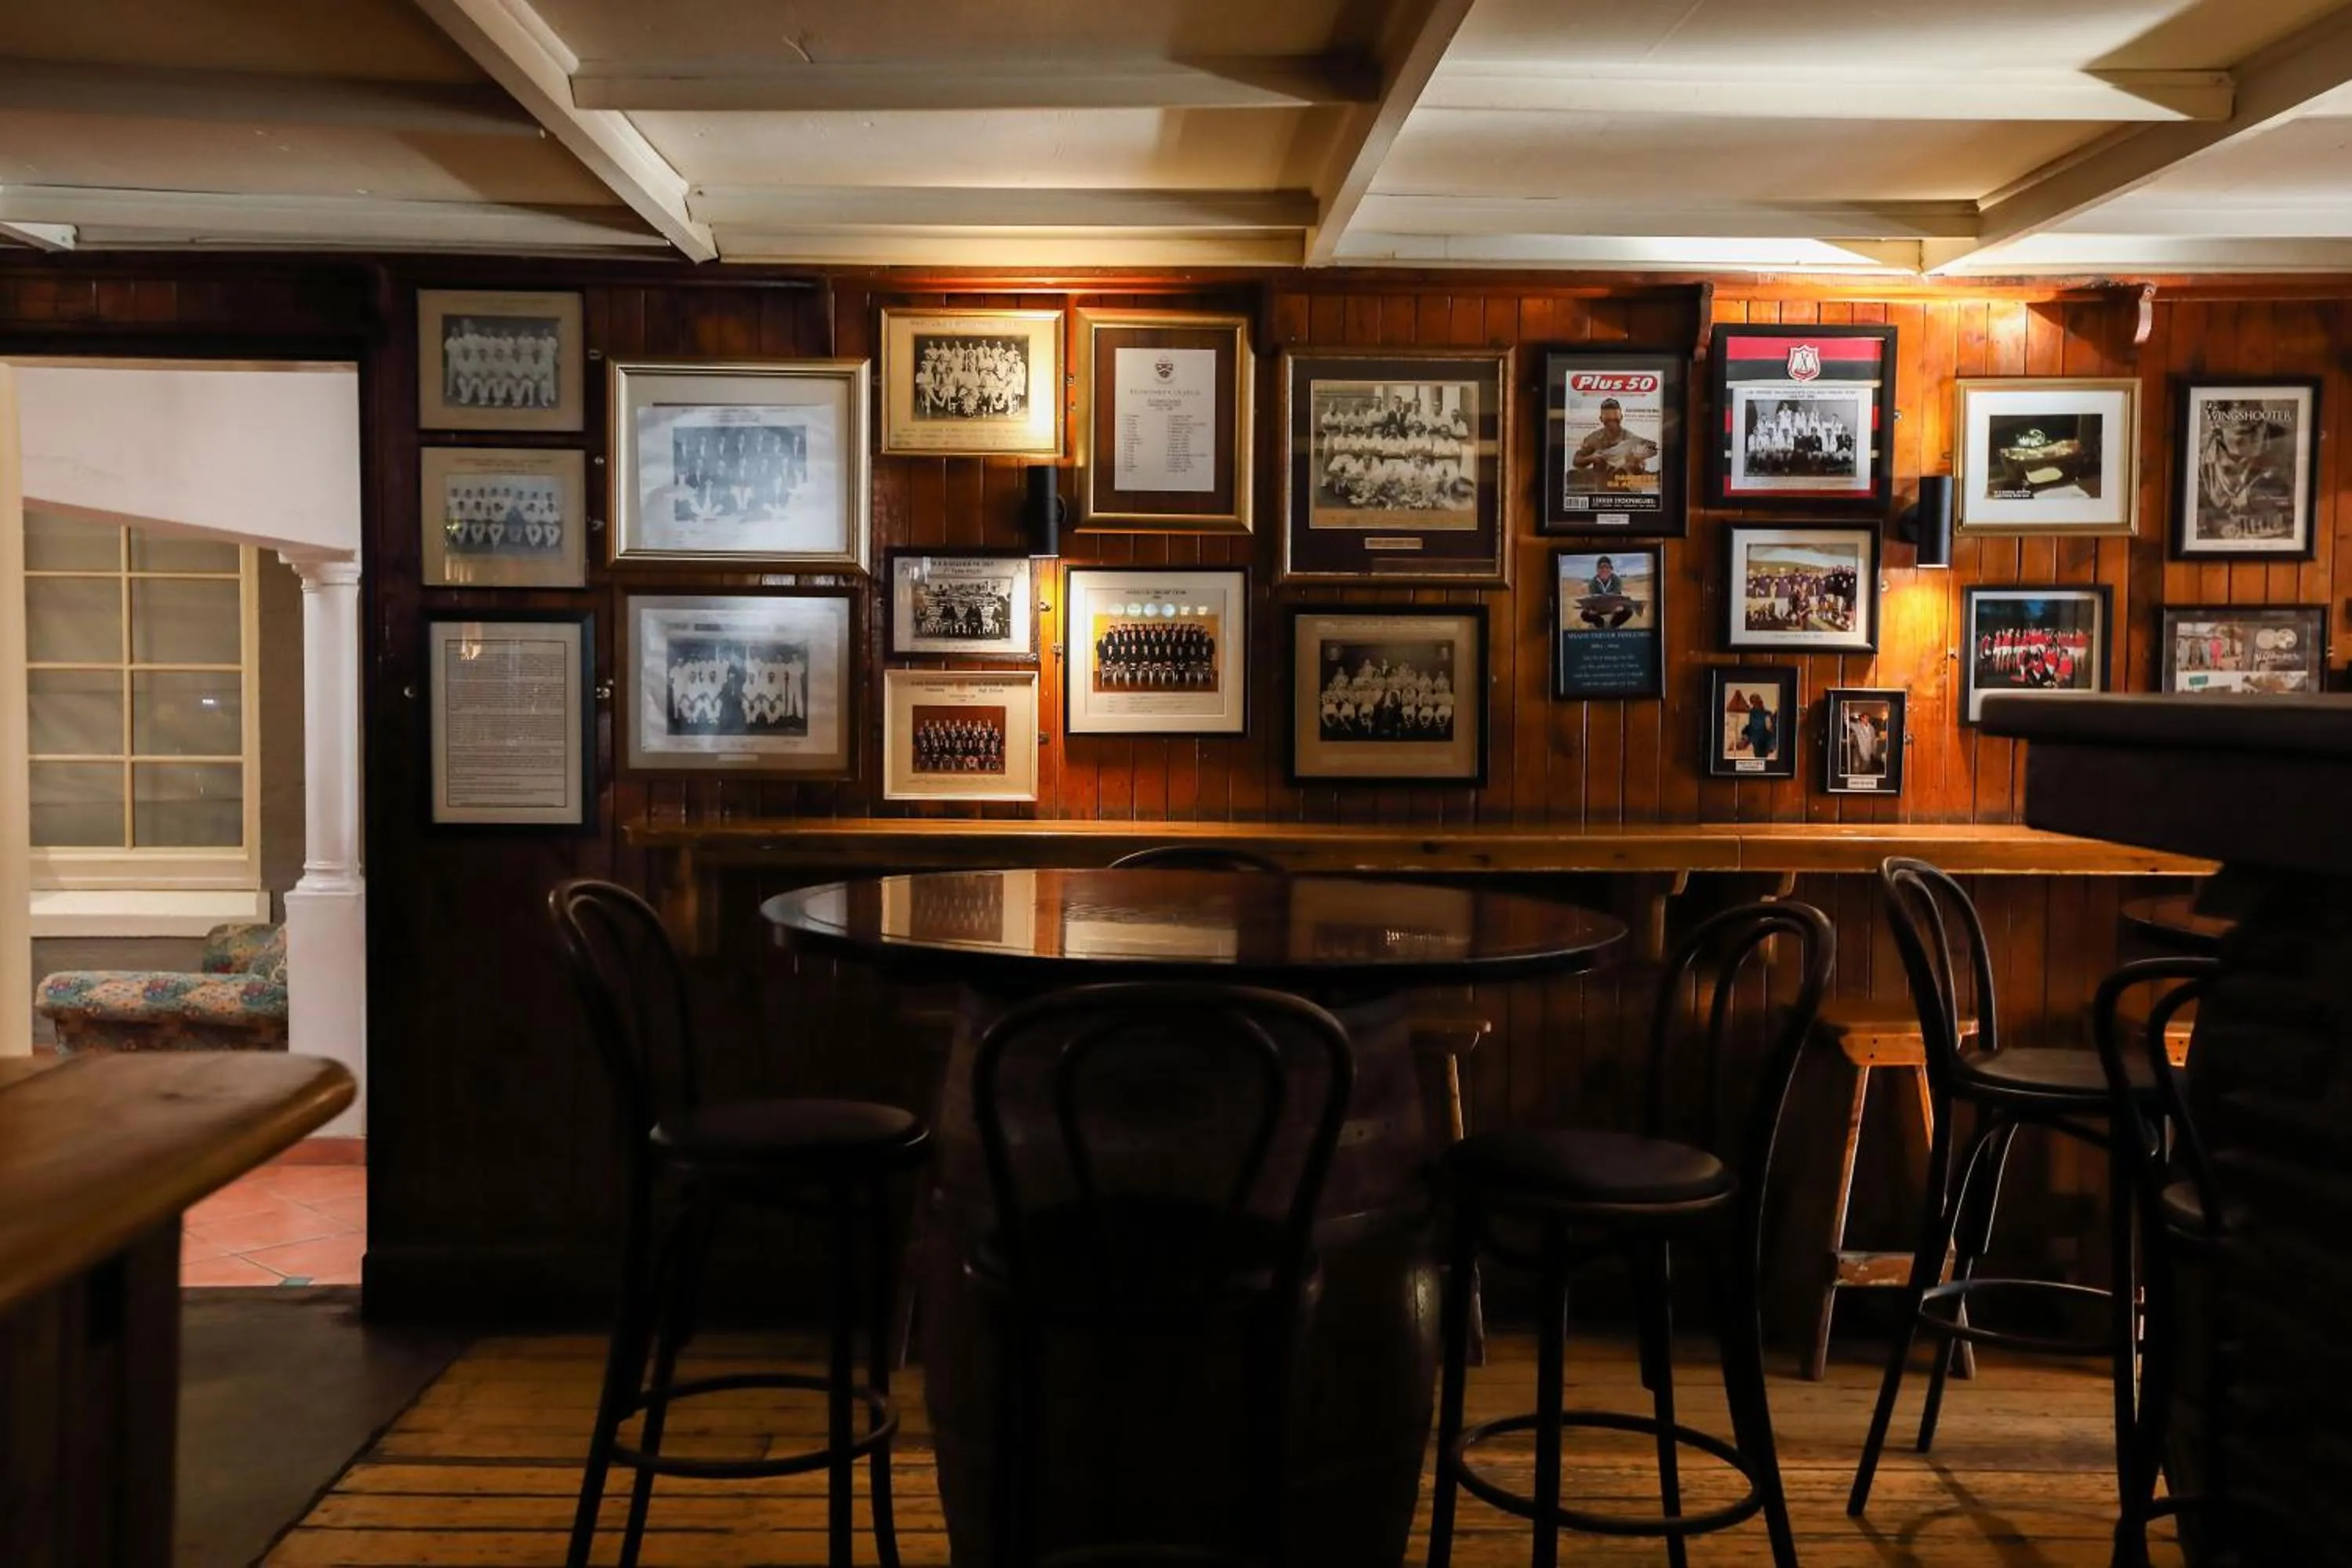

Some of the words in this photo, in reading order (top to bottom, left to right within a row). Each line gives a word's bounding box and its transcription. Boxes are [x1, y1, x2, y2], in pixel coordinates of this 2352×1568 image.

[1577, 376, 1623, 390] Plus
[1625, 377, 1653, 390] 50
[2206, 410, 2292, 421] WINGSHOOTER
